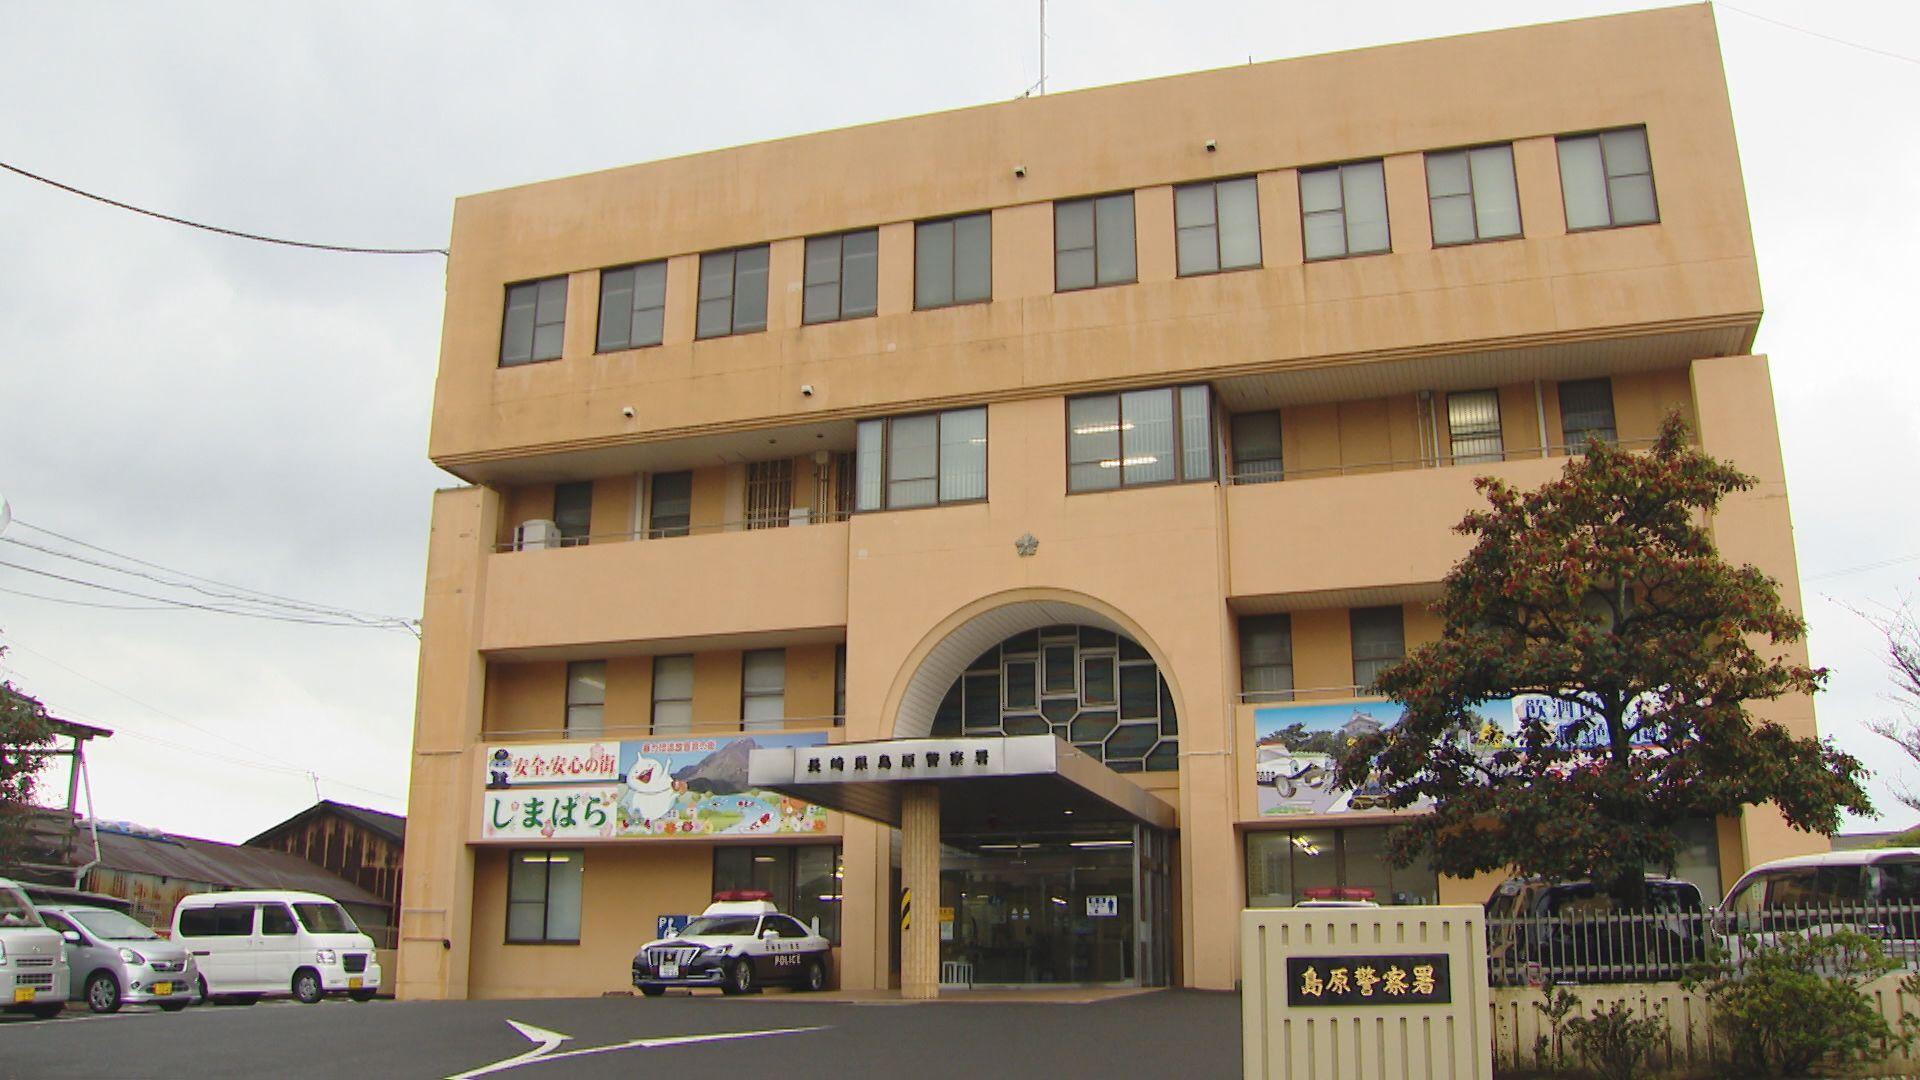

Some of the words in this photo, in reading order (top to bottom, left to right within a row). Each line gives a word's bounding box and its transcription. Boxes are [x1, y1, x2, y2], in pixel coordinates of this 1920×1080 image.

[807, 749, 989, 774] 長崎県島原警察署
[492, 793, 607, 829] しまばら
[774, 954, 801, 966] POLICE
[1299, 963, 1437, 998] 島原警察署
